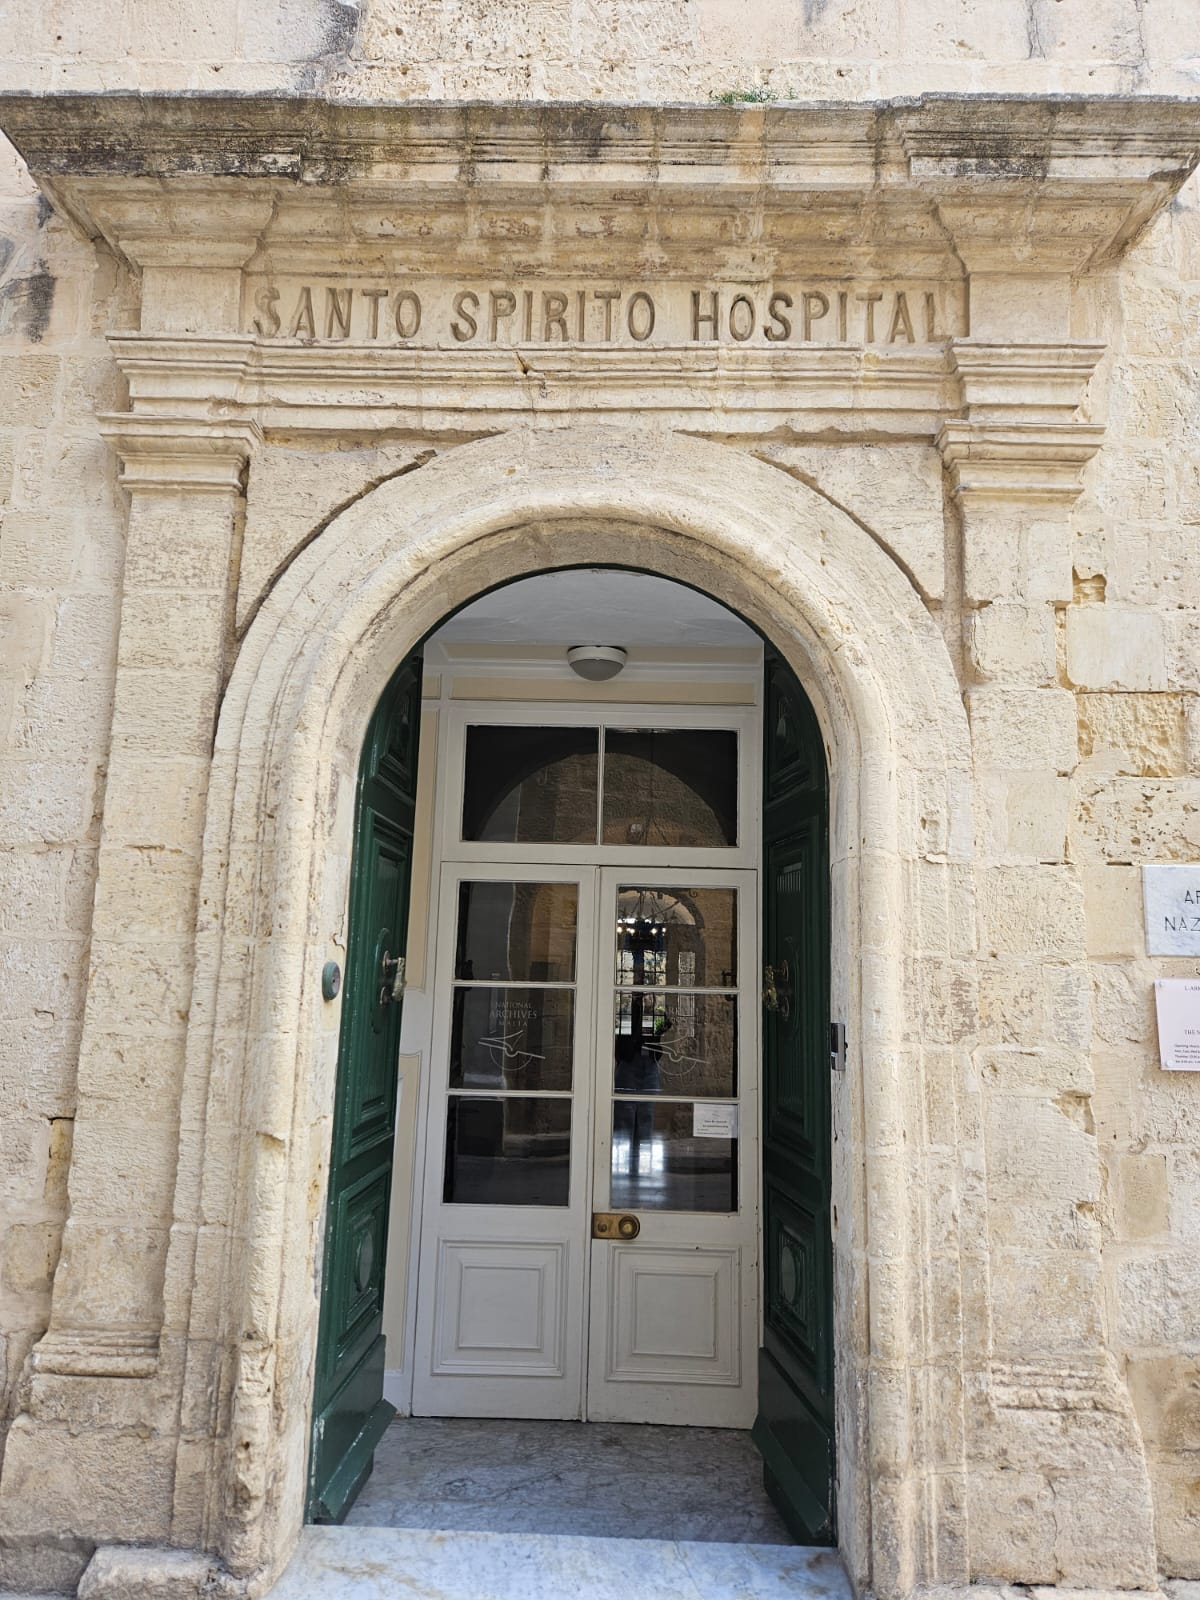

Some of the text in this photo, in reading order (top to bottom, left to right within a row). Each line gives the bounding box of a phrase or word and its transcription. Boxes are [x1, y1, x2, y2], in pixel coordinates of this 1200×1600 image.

[253, 286, 952, 343] SANTO SPIRITO HOSPITAL
[489, 1010, 537, 1019] ARCHIVES
